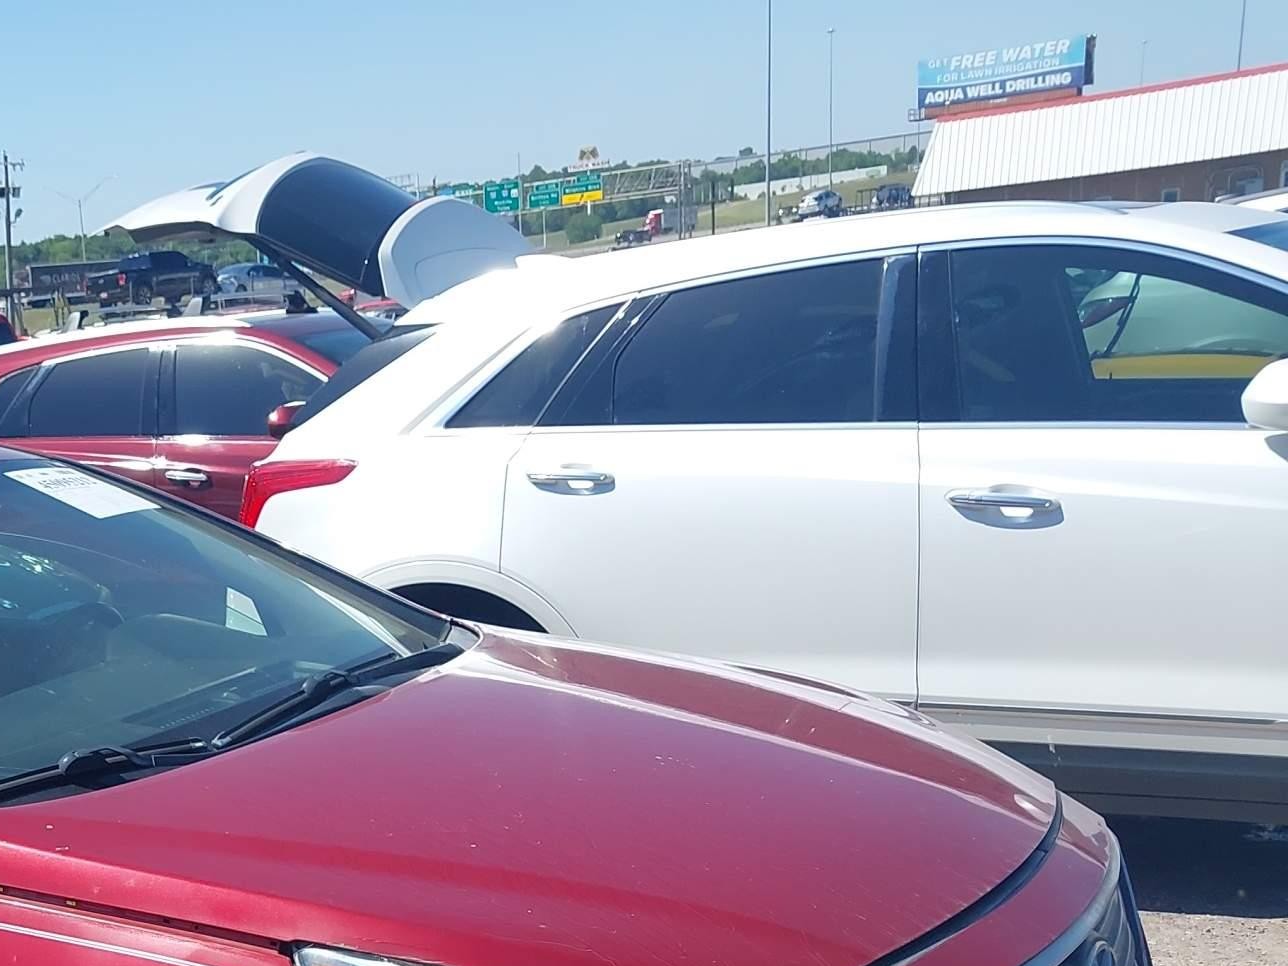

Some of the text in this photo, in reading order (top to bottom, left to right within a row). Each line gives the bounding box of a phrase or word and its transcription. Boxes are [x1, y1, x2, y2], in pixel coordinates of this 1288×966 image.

[928, 39, 1070, 70] GET FREE WATER
[936, 57, 1060, 85] FOR LAWN IRRIGATION
[924, 72, 1072, 105] AQUA WELL DRILLING
